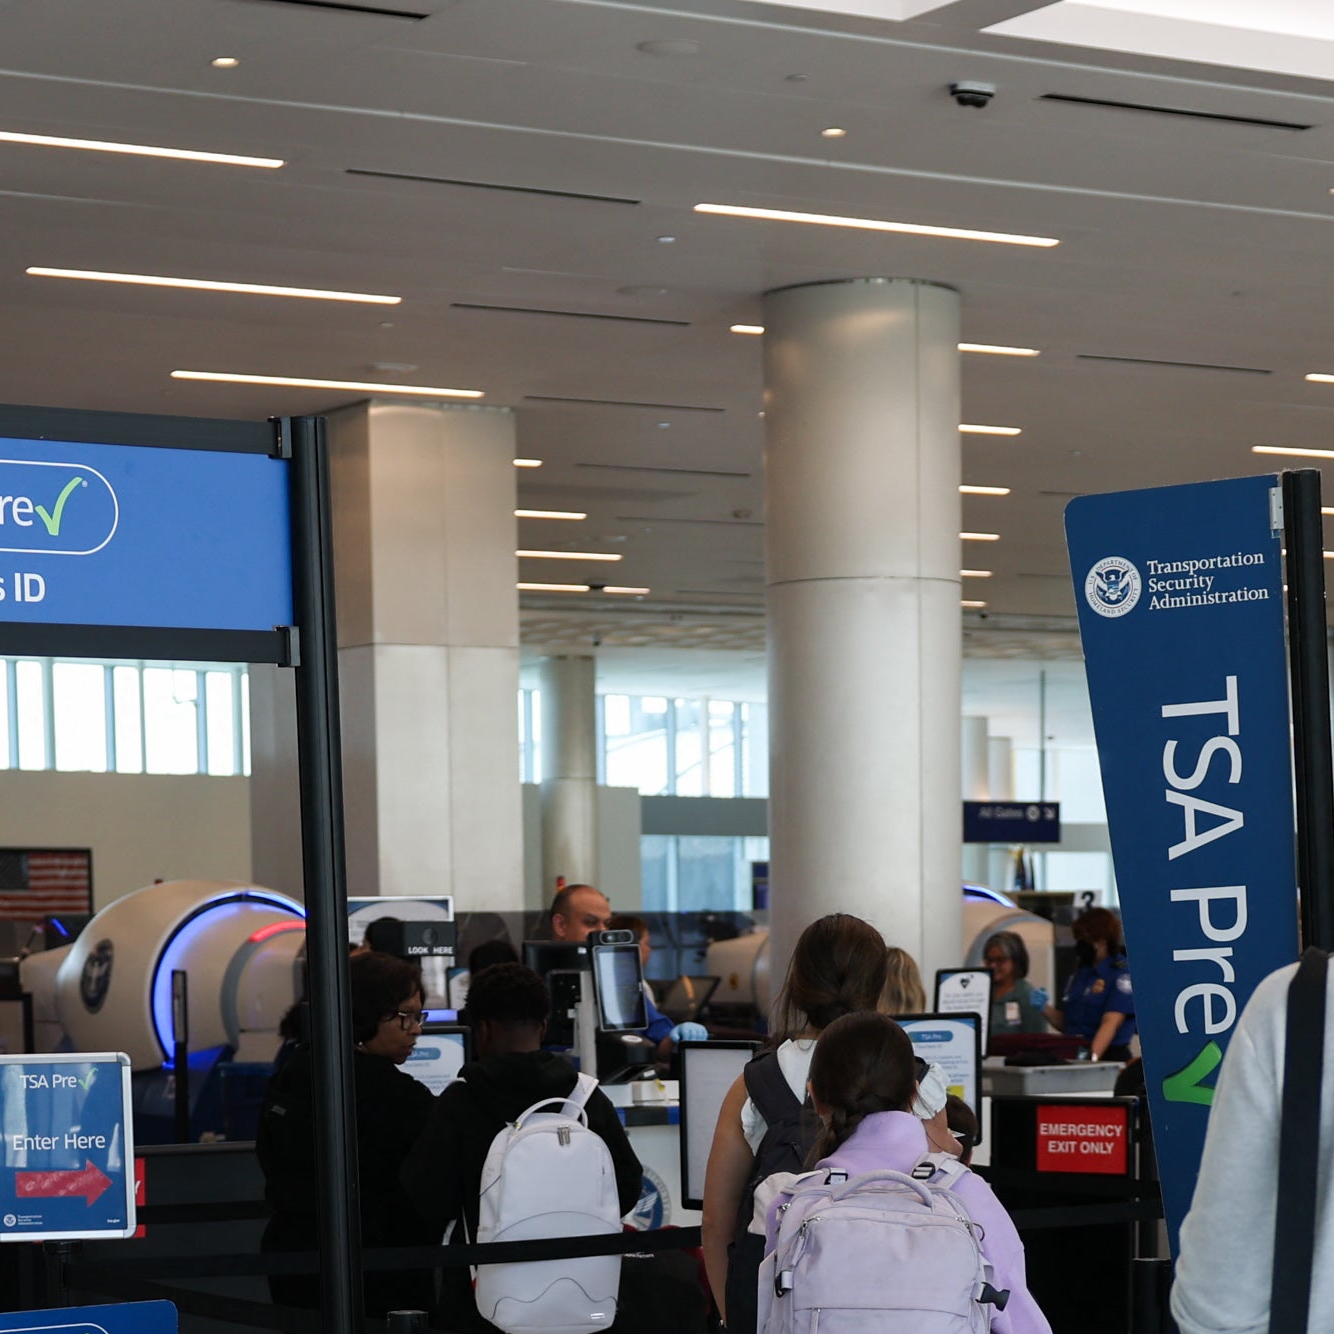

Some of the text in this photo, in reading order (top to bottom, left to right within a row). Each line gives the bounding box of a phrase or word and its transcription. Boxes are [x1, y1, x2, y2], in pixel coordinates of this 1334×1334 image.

[1147, 551, 1265, 576] Transportation
[14, 572, 46, 602] ID
[1148, 576, 1215, 598] Security
[1149, 586, 1269, 610] Administration
[1160, 675, 1248, 1035] TSA Pre
[408, 946, 454, 955] LOOK HERE
[20, 1074, 77, 1089] TSA Pre
[1040, 1123, 1122, 1137] EMERGENCY
[12, 1133, 105, 1151] Enter Here
[1048, 1140, 1114, 1154] EXIT ONLY
